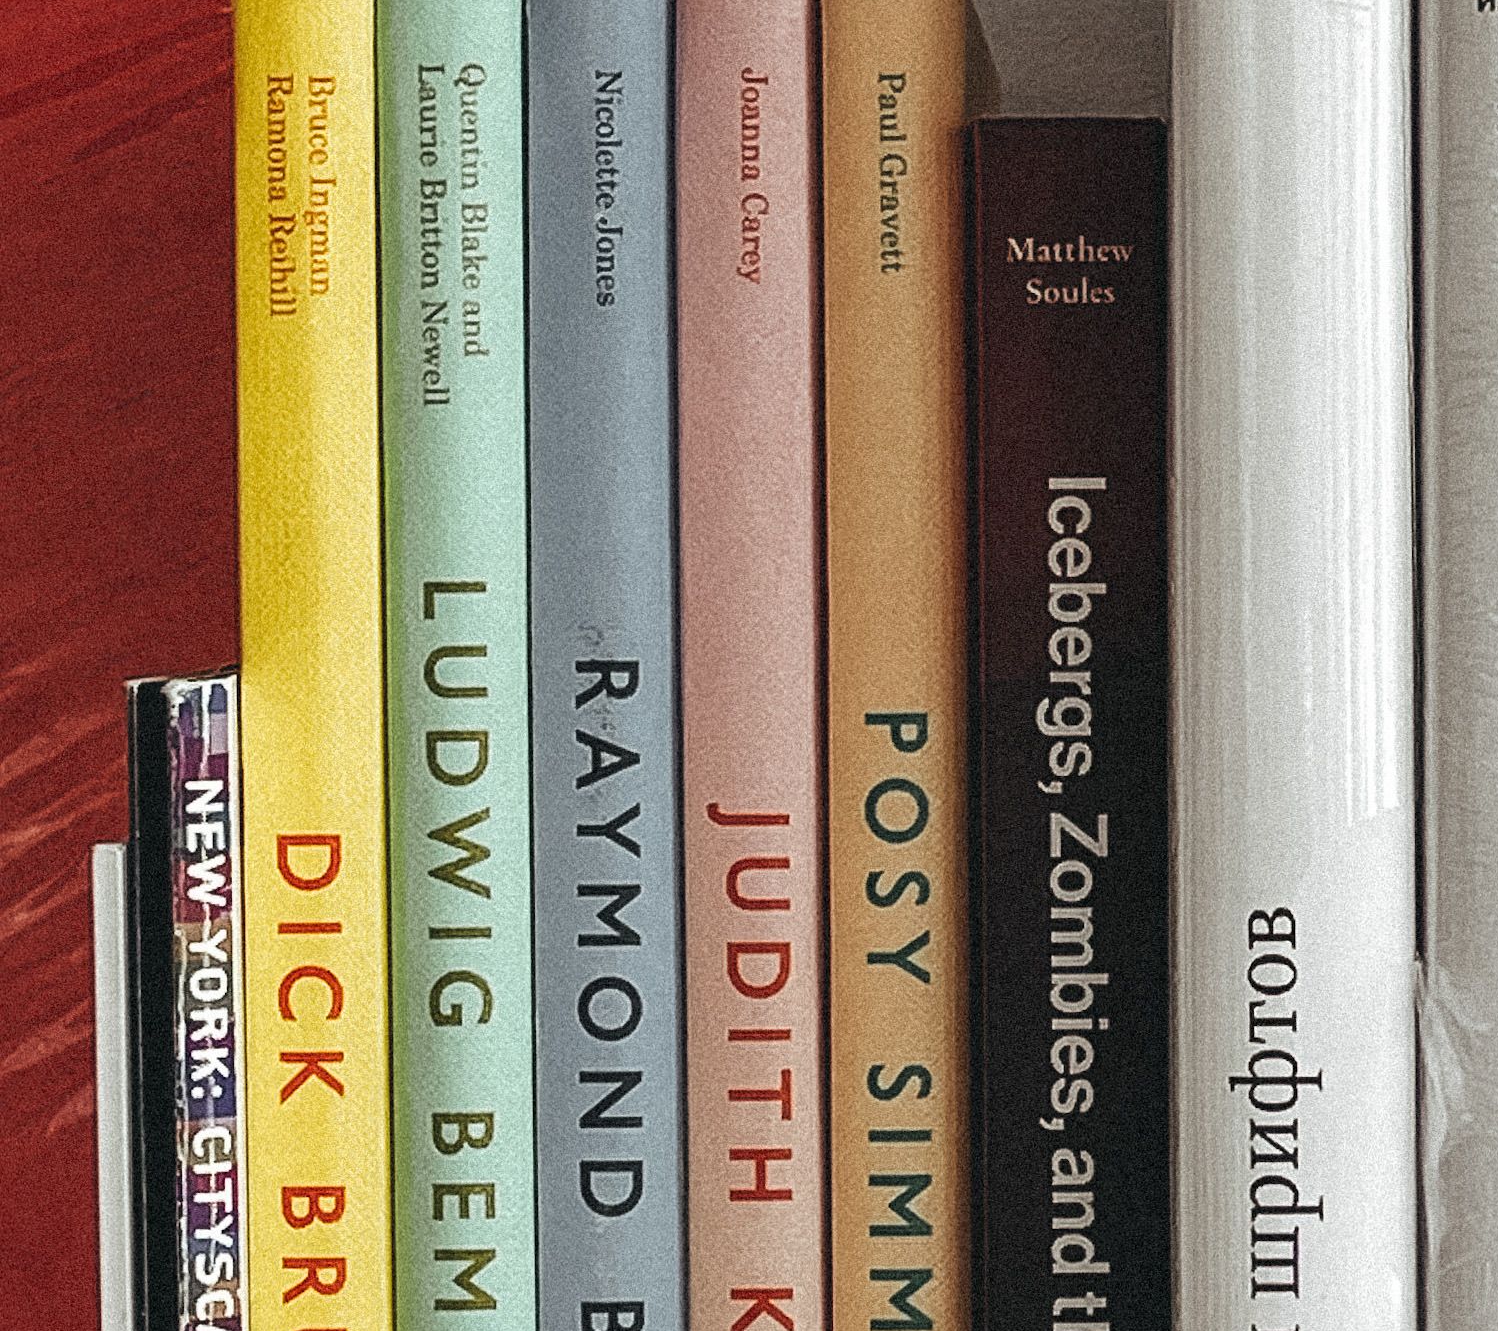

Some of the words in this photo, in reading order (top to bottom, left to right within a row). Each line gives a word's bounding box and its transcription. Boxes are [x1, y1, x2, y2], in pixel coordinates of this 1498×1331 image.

[266, 74, 293, 203] Ramona
[309, 75, 336, 165] Bruce
[418, 65, 445, 167] Laurie
[452, 63, 486, 188] Quentin
[595, 69, 623, 210] Nicolette
[739, 67, 768, 181] Joanna
[877, 72, 906, 144] Paul
[267, 214, 296, 317] Reihill
[304, 177, 336, 296] Ingman
[420, 178, 448, 289] Britton
[462, 203, 488, 290] Blake
[595, 216, 624, 307] Jones
[736, 192, 769, 284] Carey
[878, 154, 908, 274] Gravett
[1006, 235, 1135, 263] Matthew
[462, 298, 488, 357] and
[1026, 278, 1116, 305] Soules
[422, 301, 449, 406] Newell
[1034, 477, 1107, 795] Icebergs,
[183, 779, 228, 907] NEW
[422, 581, 492, 1028] LUDWIG
[863, 712, 931, 984] POSY
[276, 834, 345, 1104] DICK
[573, 659, 644, 1219] RAYMOND
[1040, 813, 1109, 1132] Zombies,
[188, 928, 230, 1099] YORK:
[705, 802, 793, 1203] JUDITH
[1229, 906, 1325, 1300] шрифтов
[1050, 1148, 1111, 1274] and
